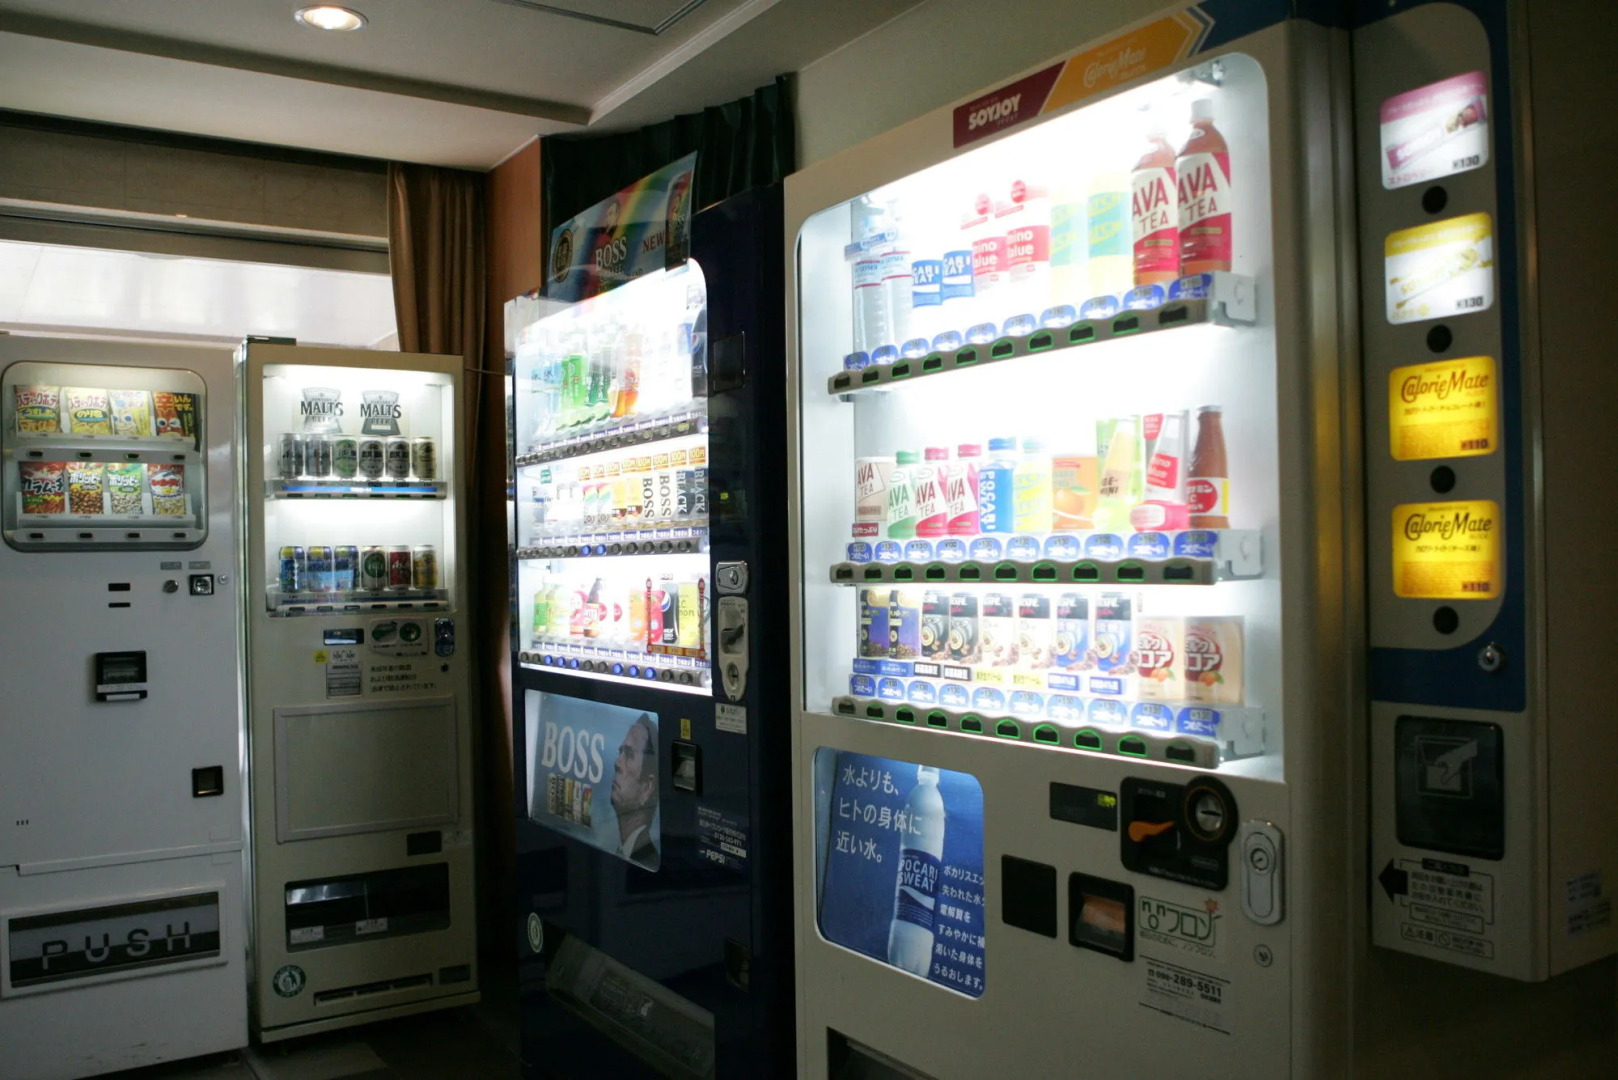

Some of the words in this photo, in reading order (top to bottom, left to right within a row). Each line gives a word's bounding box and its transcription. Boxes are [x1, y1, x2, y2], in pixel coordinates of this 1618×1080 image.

[968, 93, 1021, 130] SOYJOY
[1453, 155, 1480, 170] ¥130
[1140, 209, 1169, 231] TEA
[1186, 198, 1217, 222] TEA
[595, 237, 627, 272] BOSS
[1456, 295, 1484, 309] ¥130
[643, 477, 655, 519] BOSS
[660, 475, 671, 518] BOSS
[695, 466, 706, 514] BLACK
[860, 482, 874, 495] TEA
[986, 470, 996, 530] POCARI
[893, 506, 909, 519] TEA
[920, 504, 936, 517] TEA
[950, 502, 965, 515] TEA
[541, 720, 605, 784] BOSS
[842, 764, 899, 797] 水よりも、
[838, 798, 922, 835] ヒトの身体に
[706, 849, 726, 864] PEPSI
[835, 830, 883, 864] 近い水。
[900, 858, 938, 882] POCARI
[899, 874, 935, 893] SWEAT
[940, 904, 971, 923] 電解質を
[41, 921, 191, 970] PUSH
[933, 963, 983, 989] うるおします。
